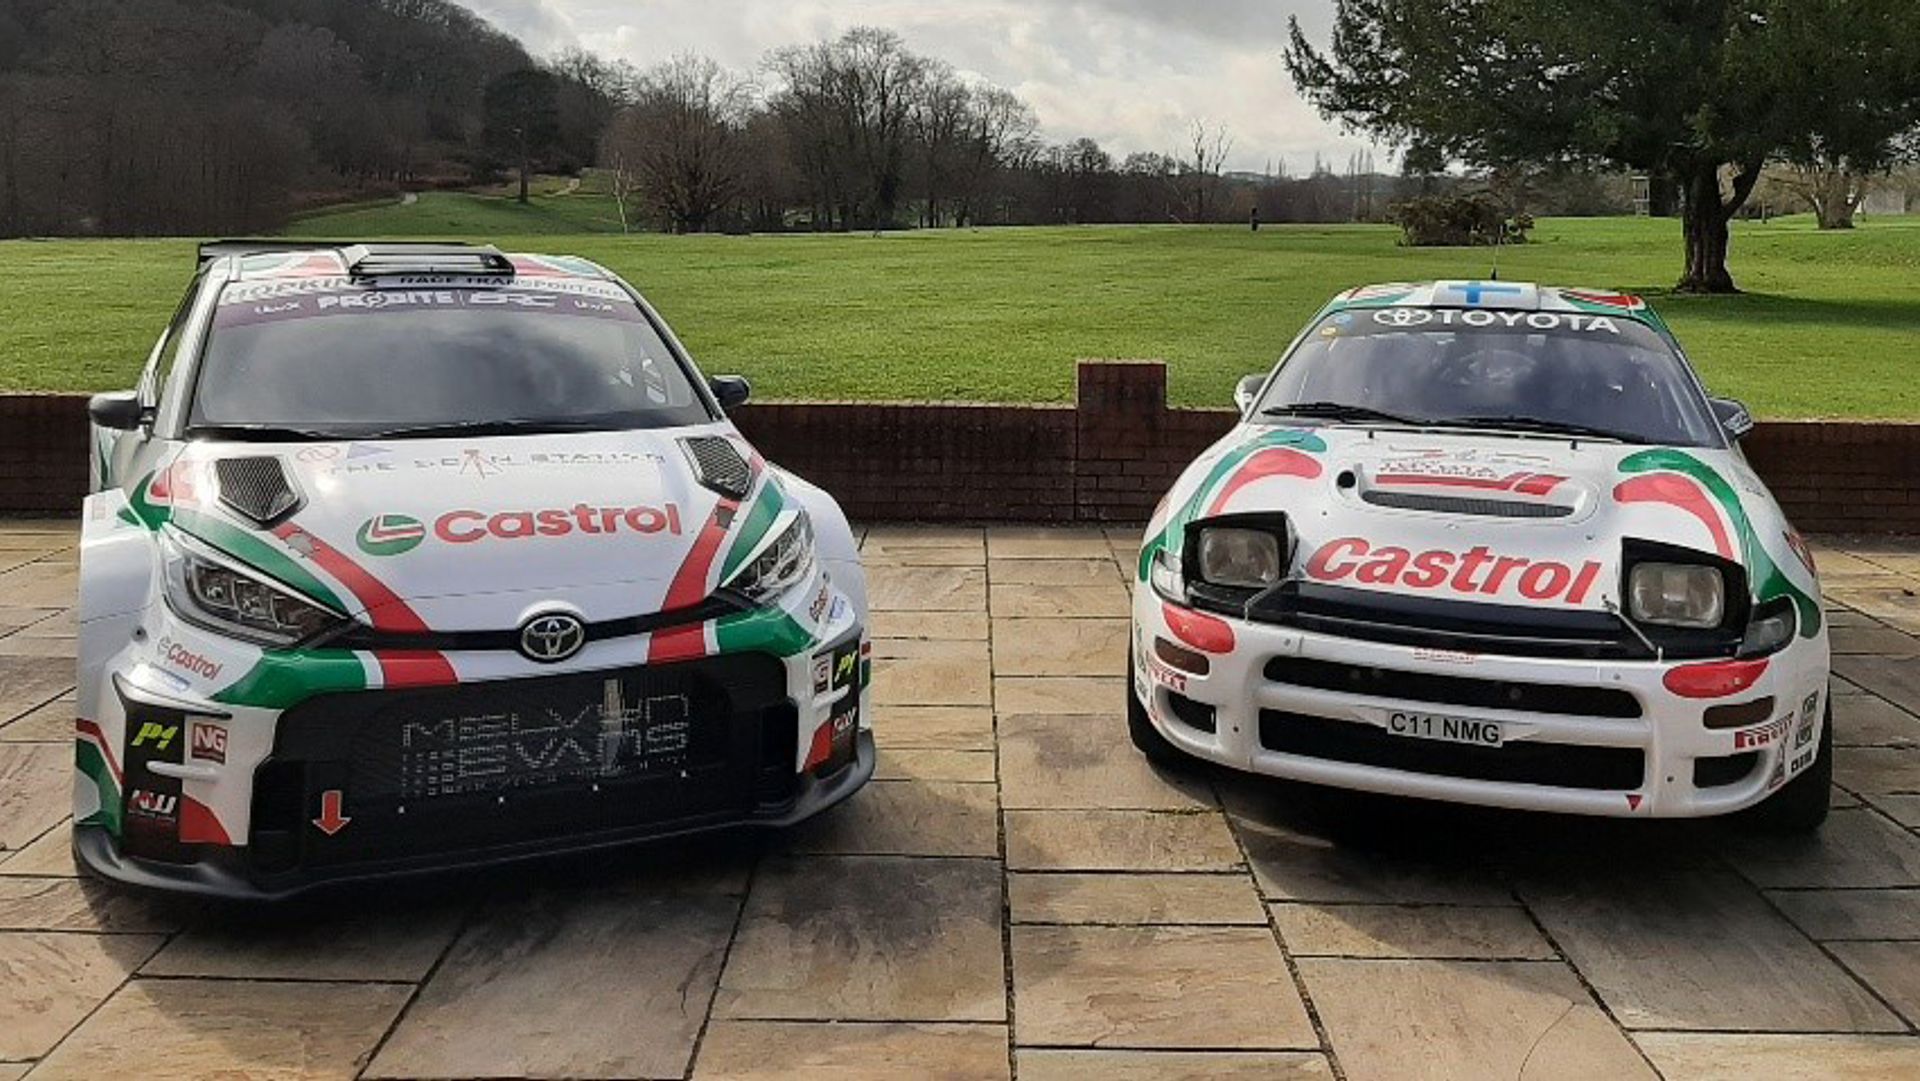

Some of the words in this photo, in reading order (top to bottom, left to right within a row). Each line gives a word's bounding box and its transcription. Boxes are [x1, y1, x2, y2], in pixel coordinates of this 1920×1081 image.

[1436, 309, 1620, 334] TOYOTA
[433, 503, 681, 542] Castrol
[1305, 536, 1604, 605] Castrol
[167, 643, 225, 680] Castrol
[131, 721, 178, 750] P1
[194, 724, 226, 752] NG
[1391, 713, 1431, 735] C11
[1443, 718, 1499, 744] NMG
